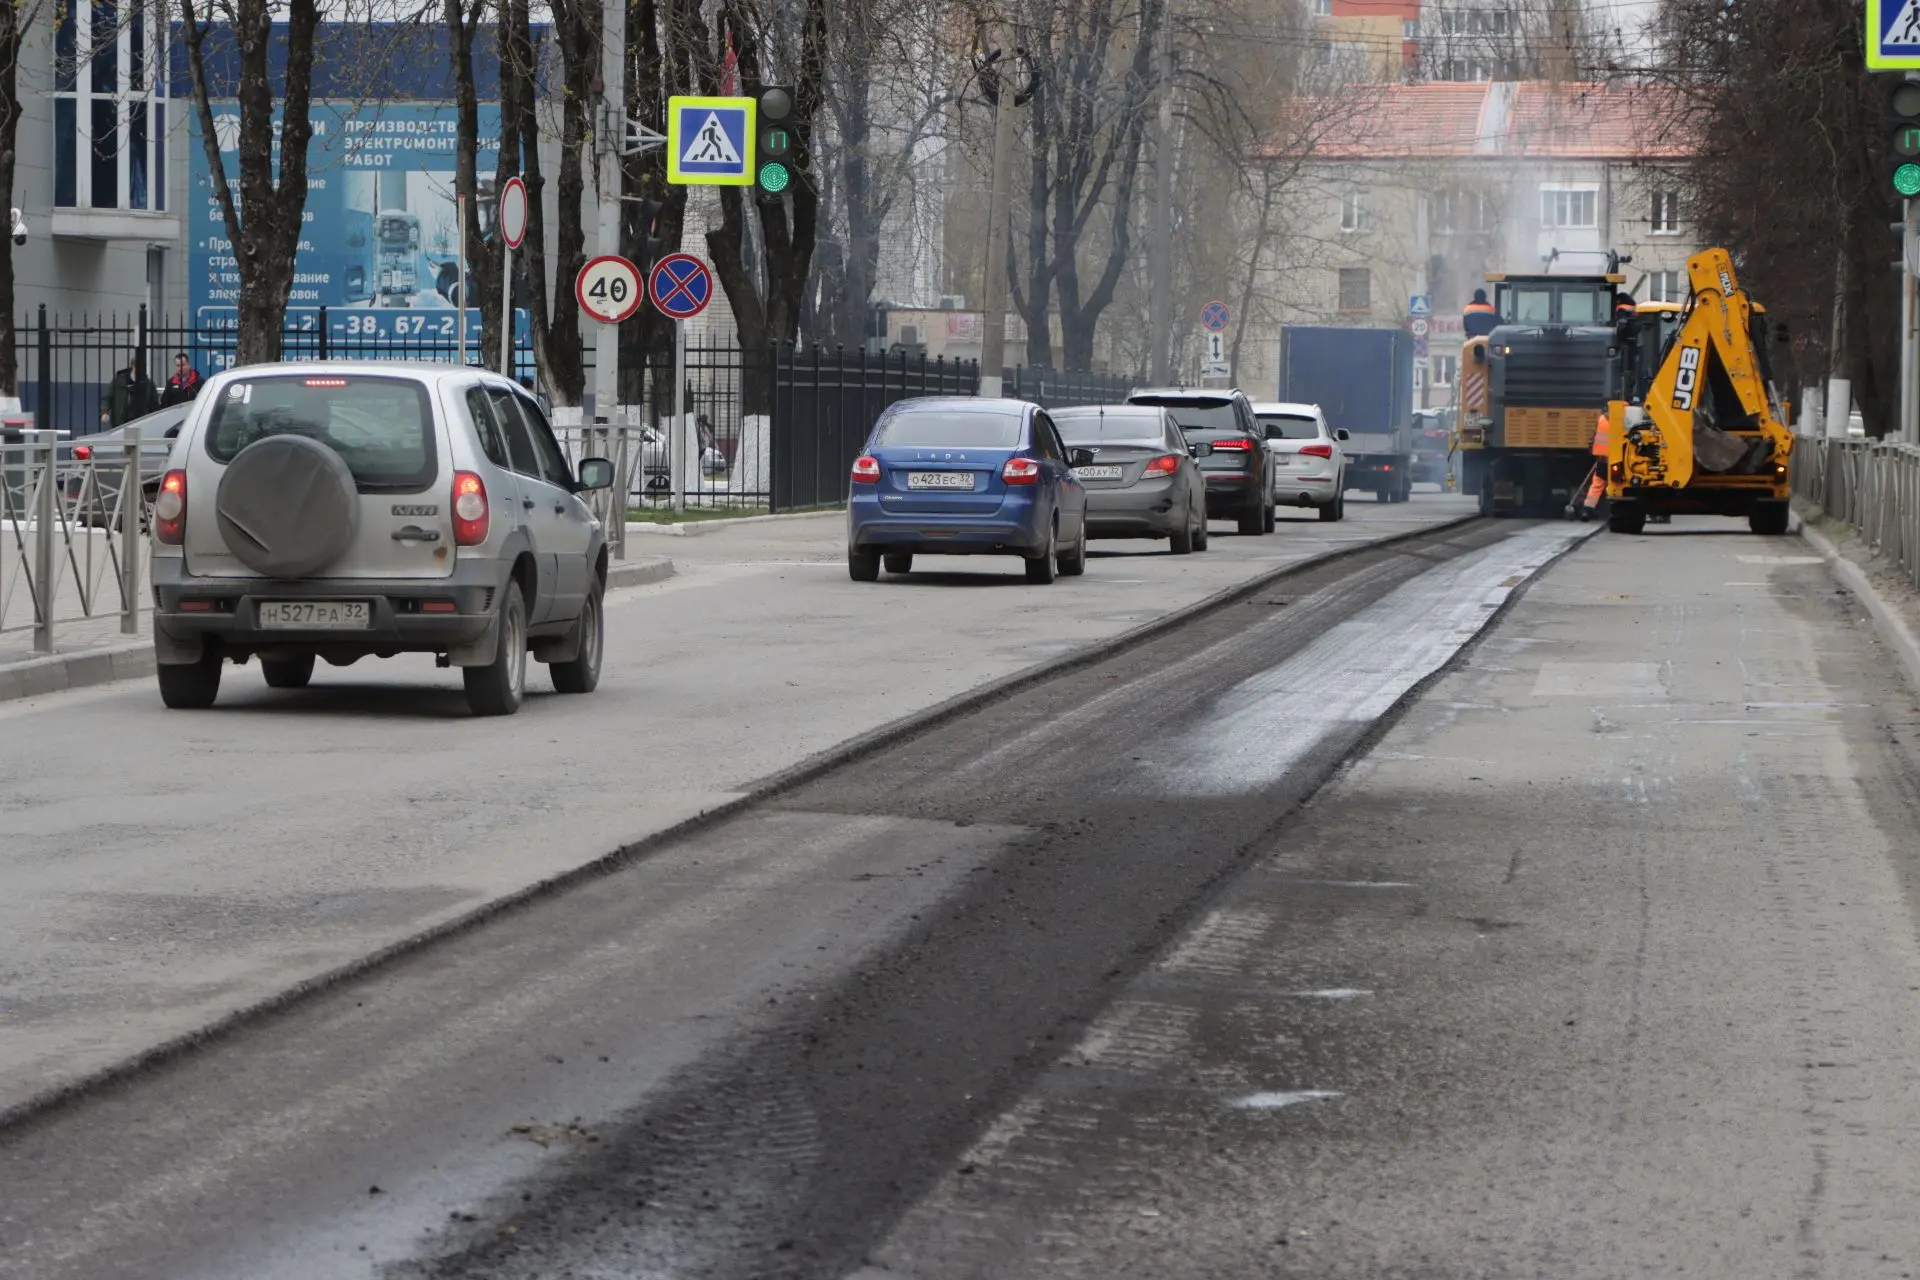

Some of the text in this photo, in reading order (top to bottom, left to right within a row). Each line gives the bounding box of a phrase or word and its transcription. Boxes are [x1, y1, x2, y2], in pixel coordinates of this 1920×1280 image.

[344, 121, 457, 133] ПРОИЗВОДСТВ
[344, 154, 393, 166] РАБОТ
[589, 277, 627, 303] 40
[1672, 346, 1700, 410] JCB
[393, 505, 438, 516] NIVA
[344, 604, 363, 618] 32
